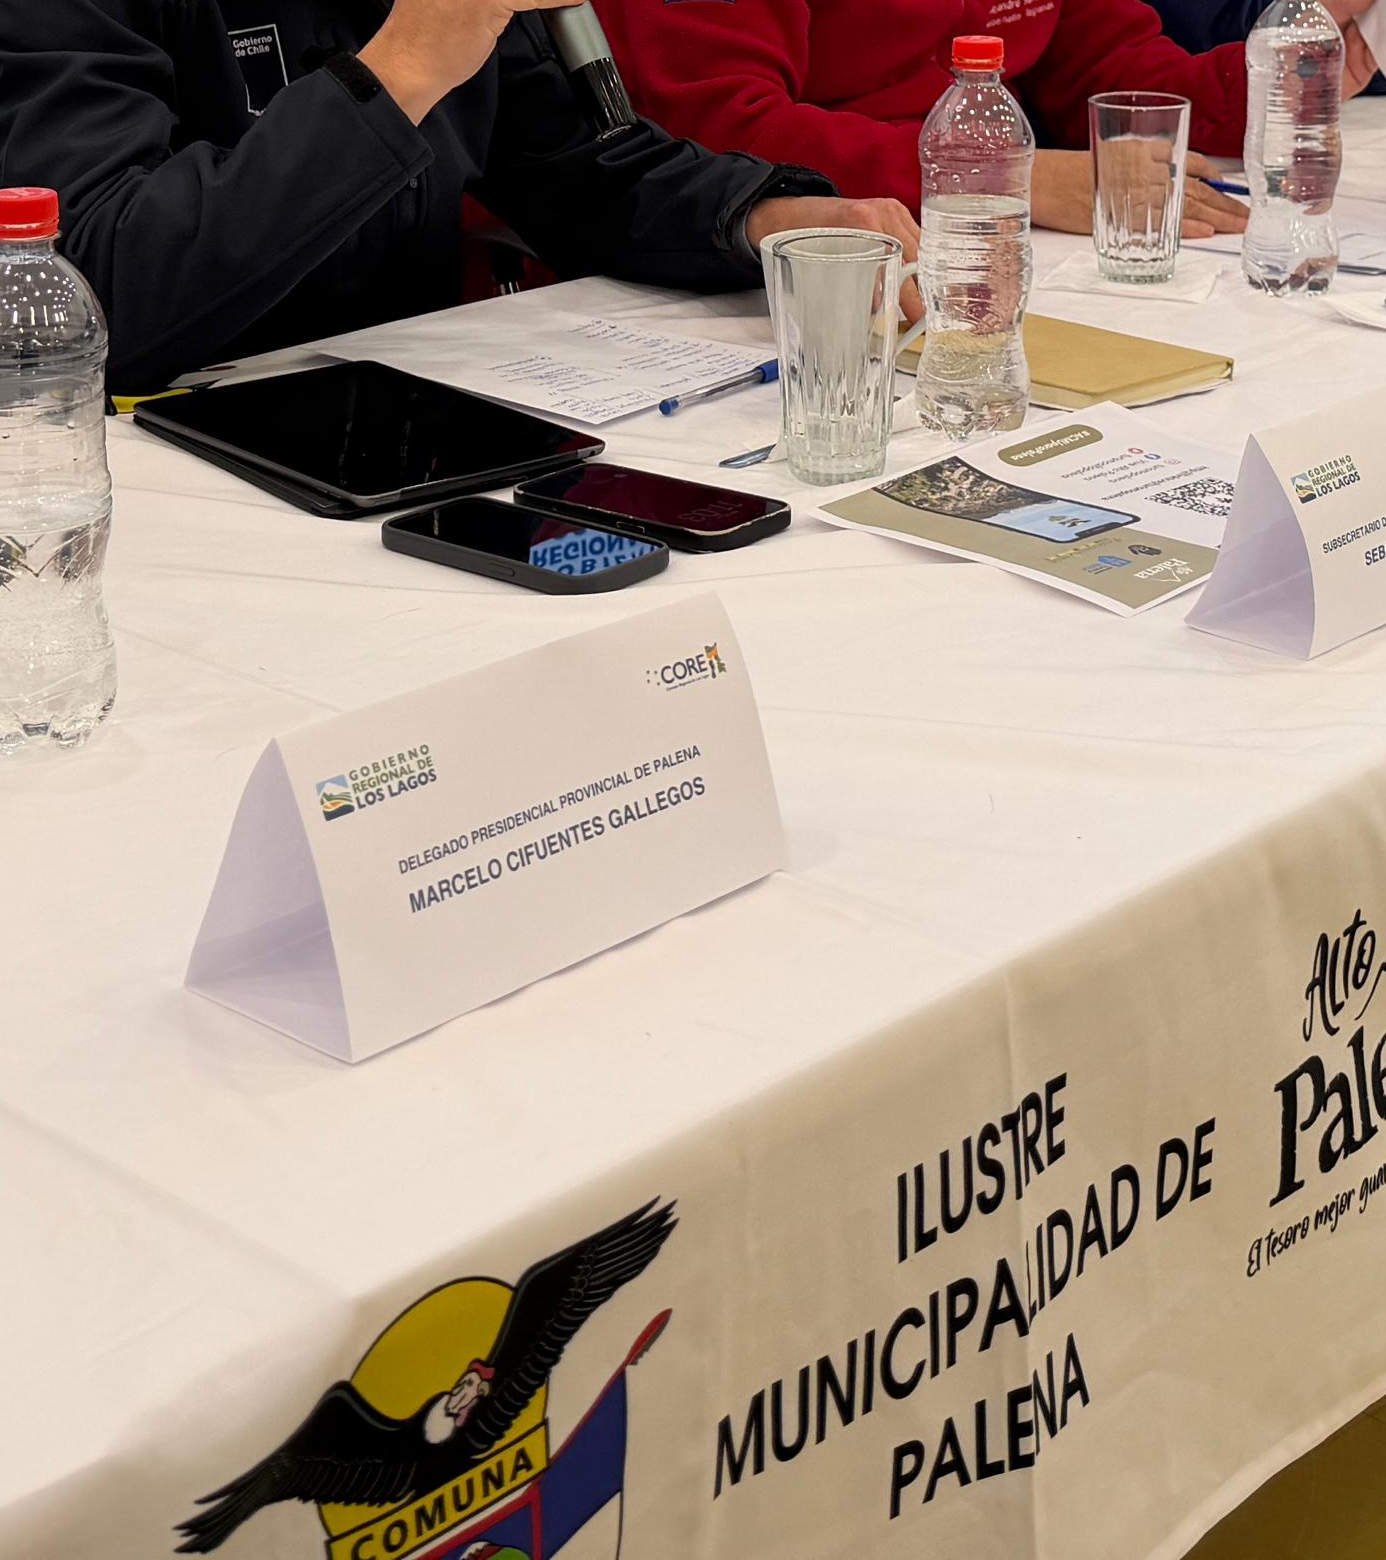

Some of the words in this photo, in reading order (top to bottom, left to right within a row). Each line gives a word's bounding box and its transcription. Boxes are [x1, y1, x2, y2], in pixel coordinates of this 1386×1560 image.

[233, 36, 272, 48] Gobierno
[235, 49, 245, 57] de
[247, 45, 269, 56] Chile
[1308, 455, 1352, 477] GOBIERNO
[1312, 469, 1346, 486] REGIONAL
[1346, 463, 1356, 472] DE
[1316, 483, 1332, 497] LOS
[1333, 472, 1360, 489] LAGOS
[1323, 519, 1380, 553] SUBSECRETARIO
[661, 654, 708, 683] CORE
[349, 745, 429, 781] GOBIERNO
[352, 765, 415, 794] REGIONAL
[417, 756, 433, 770] DE
[355, 788, 384, 809] LOS
[388, 769, 437, 797] LAGOS
[398, 835, 469, 874] DELEGADO
[471, 800, 558, 845] PRESIDENCIAL
[560, 772, 632, 809] PROVINCIAL
[634, 763, 651, 780] DE
[653, 745, 701, 773] PALENA
[409, 859, 502, 913] MARCELO
[506, 816, 605, 872] CIFUENTES
[608, 777, 705, 829] GALLEGOS
[1303, 909, 1376, 1042] Alto
[897, 1072, 1067, 1264] ILUSTRE
[1247, 1237, 1262, 1277] El
[1266, 1216, 1309, 1265] tesoro
[1314, 1188, 1355, 1232] mejor
[714, 1164, 1140, 1500] MUNICIPALIDAD
[1156, 1117, 1215, 1221] DE
[890, 1333, 1090, 1520] PALENA
[352, 1445, 535, 1560] COMUNA
